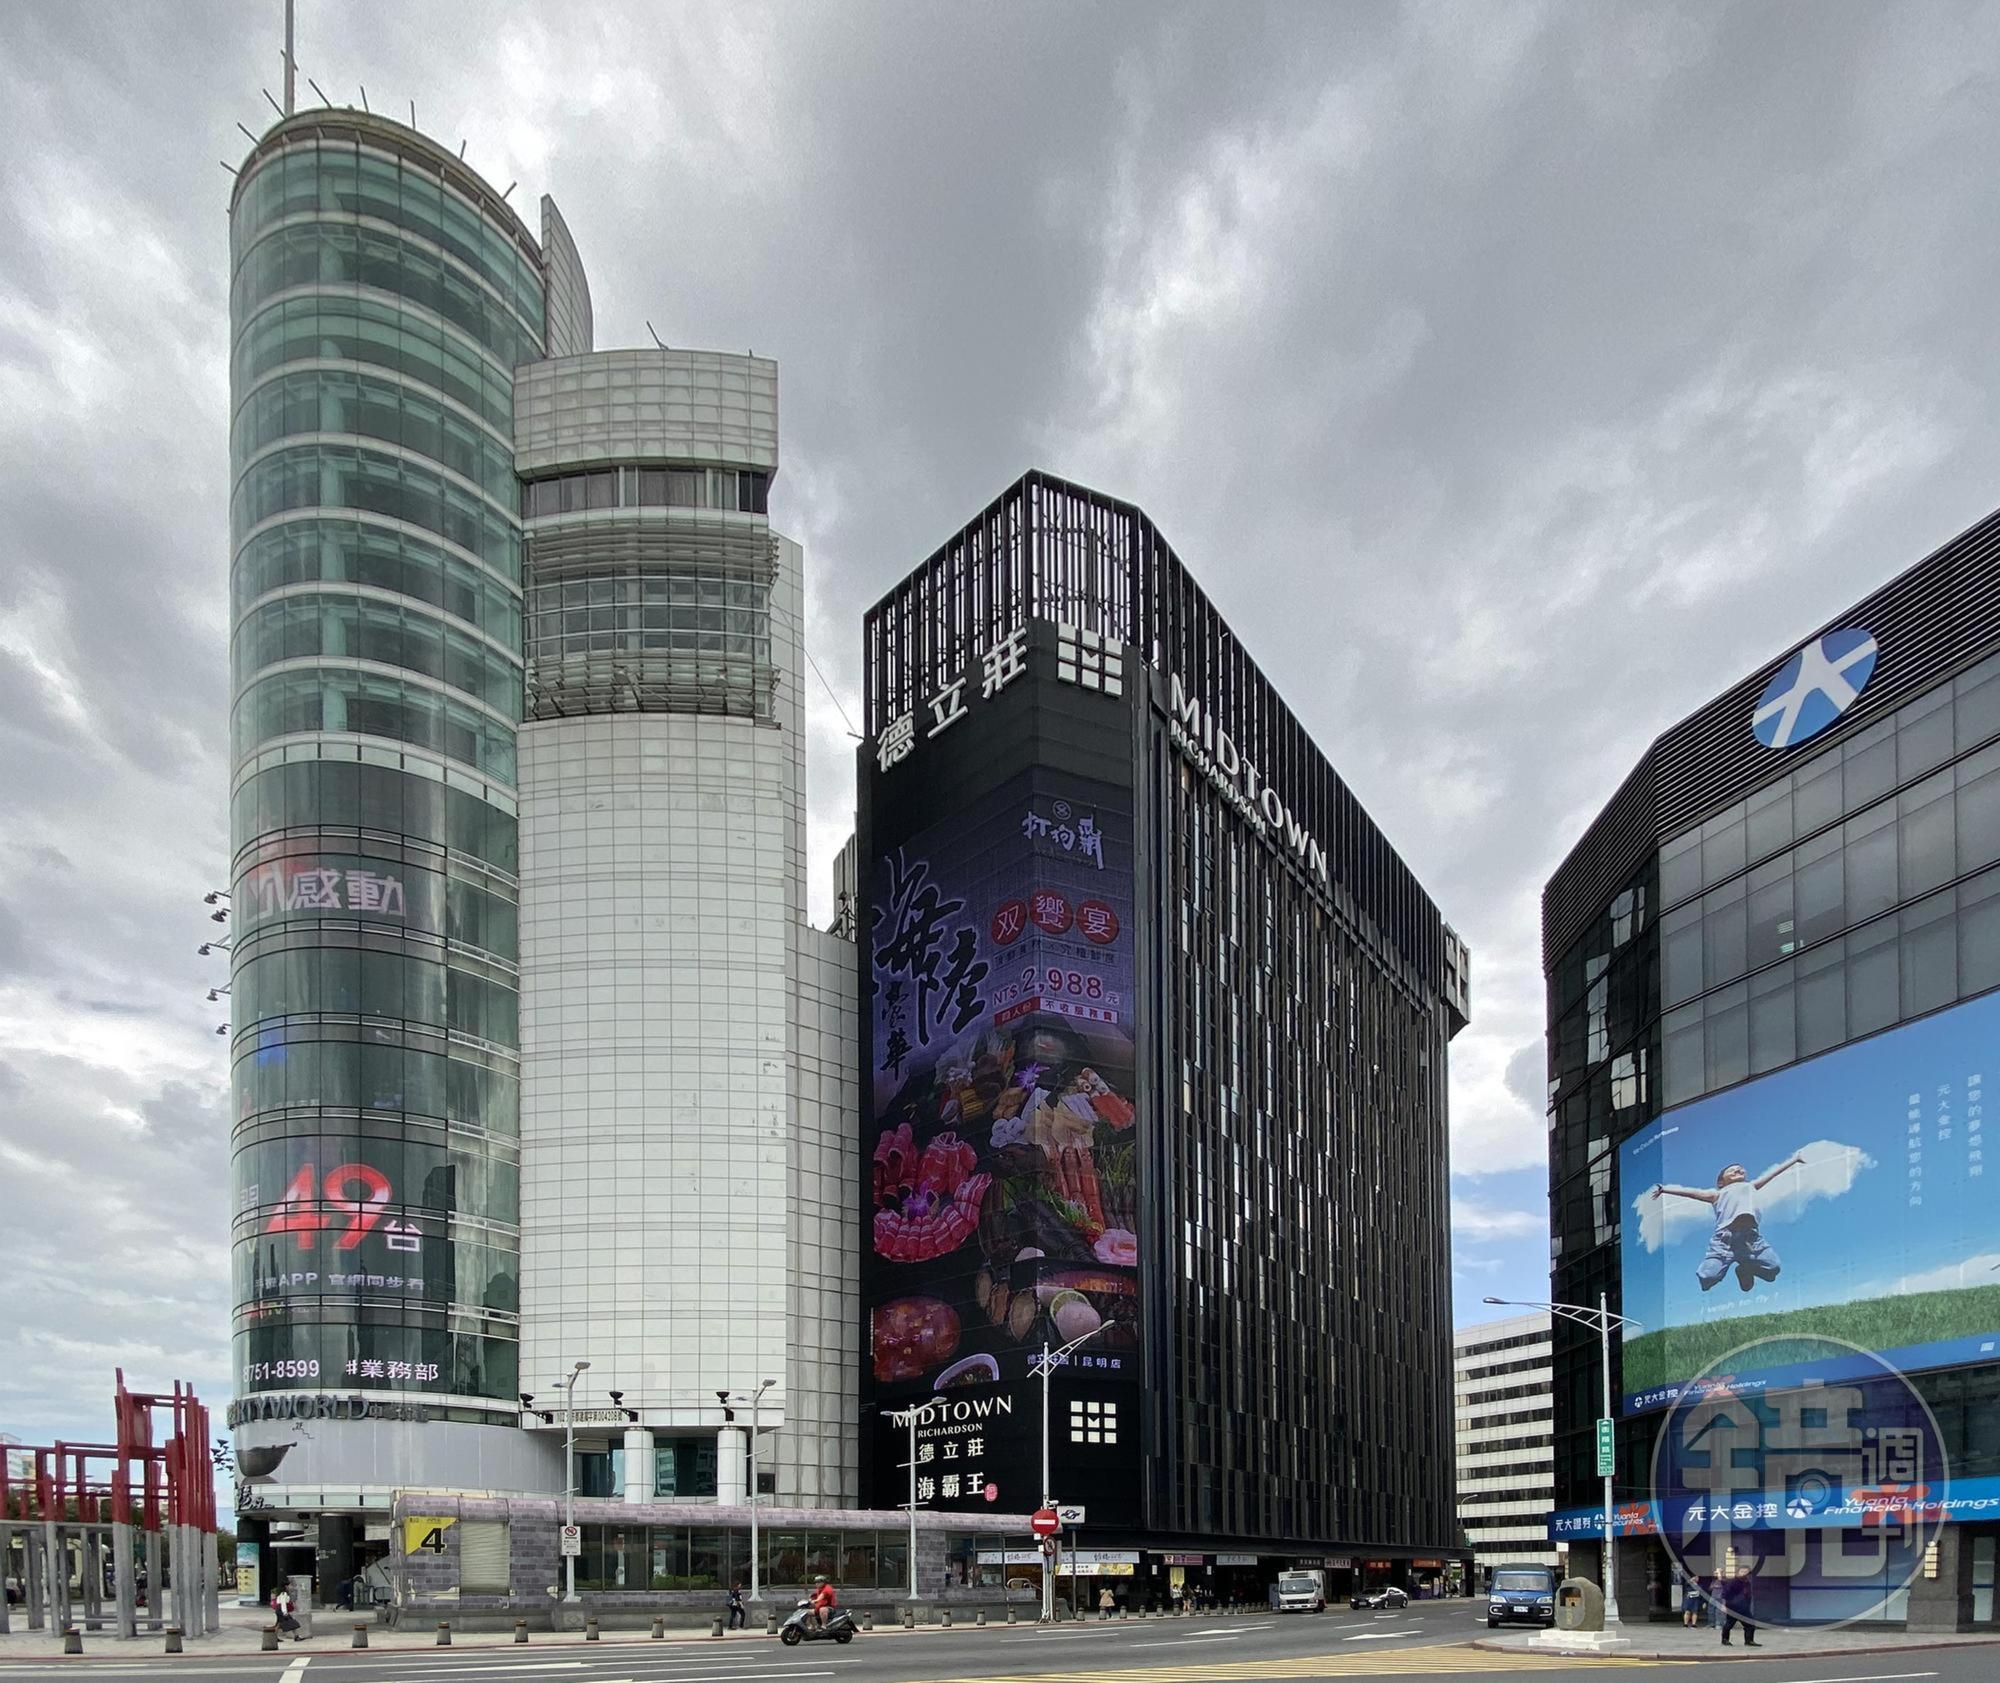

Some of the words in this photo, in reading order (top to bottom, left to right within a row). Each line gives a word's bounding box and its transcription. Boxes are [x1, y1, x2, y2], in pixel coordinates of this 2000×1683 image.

[876, 627, 1027, 773] 德立莊
[1171, 672, 1328, 883] MIDTOWN
[1082, 1356, 1121, 1369] 昆明店
[892, 1395, 1012, 1429] MIDTOWN
[918, 1423, 983, 1438] RICHARDSON
[918, 1438, 985, 1462] 德立莊
[918, 1472, 985, 1500] 海霸王
[1688, 1502, 1778, 1522] 元大金控
[1823, 1503, 1907, 1516] Financial
[1911, 1497, 2000, 1512] Holdings
[1842, 1495, 1910, 1509] Yuanta
[421, 1528, 446, 1554] 4
